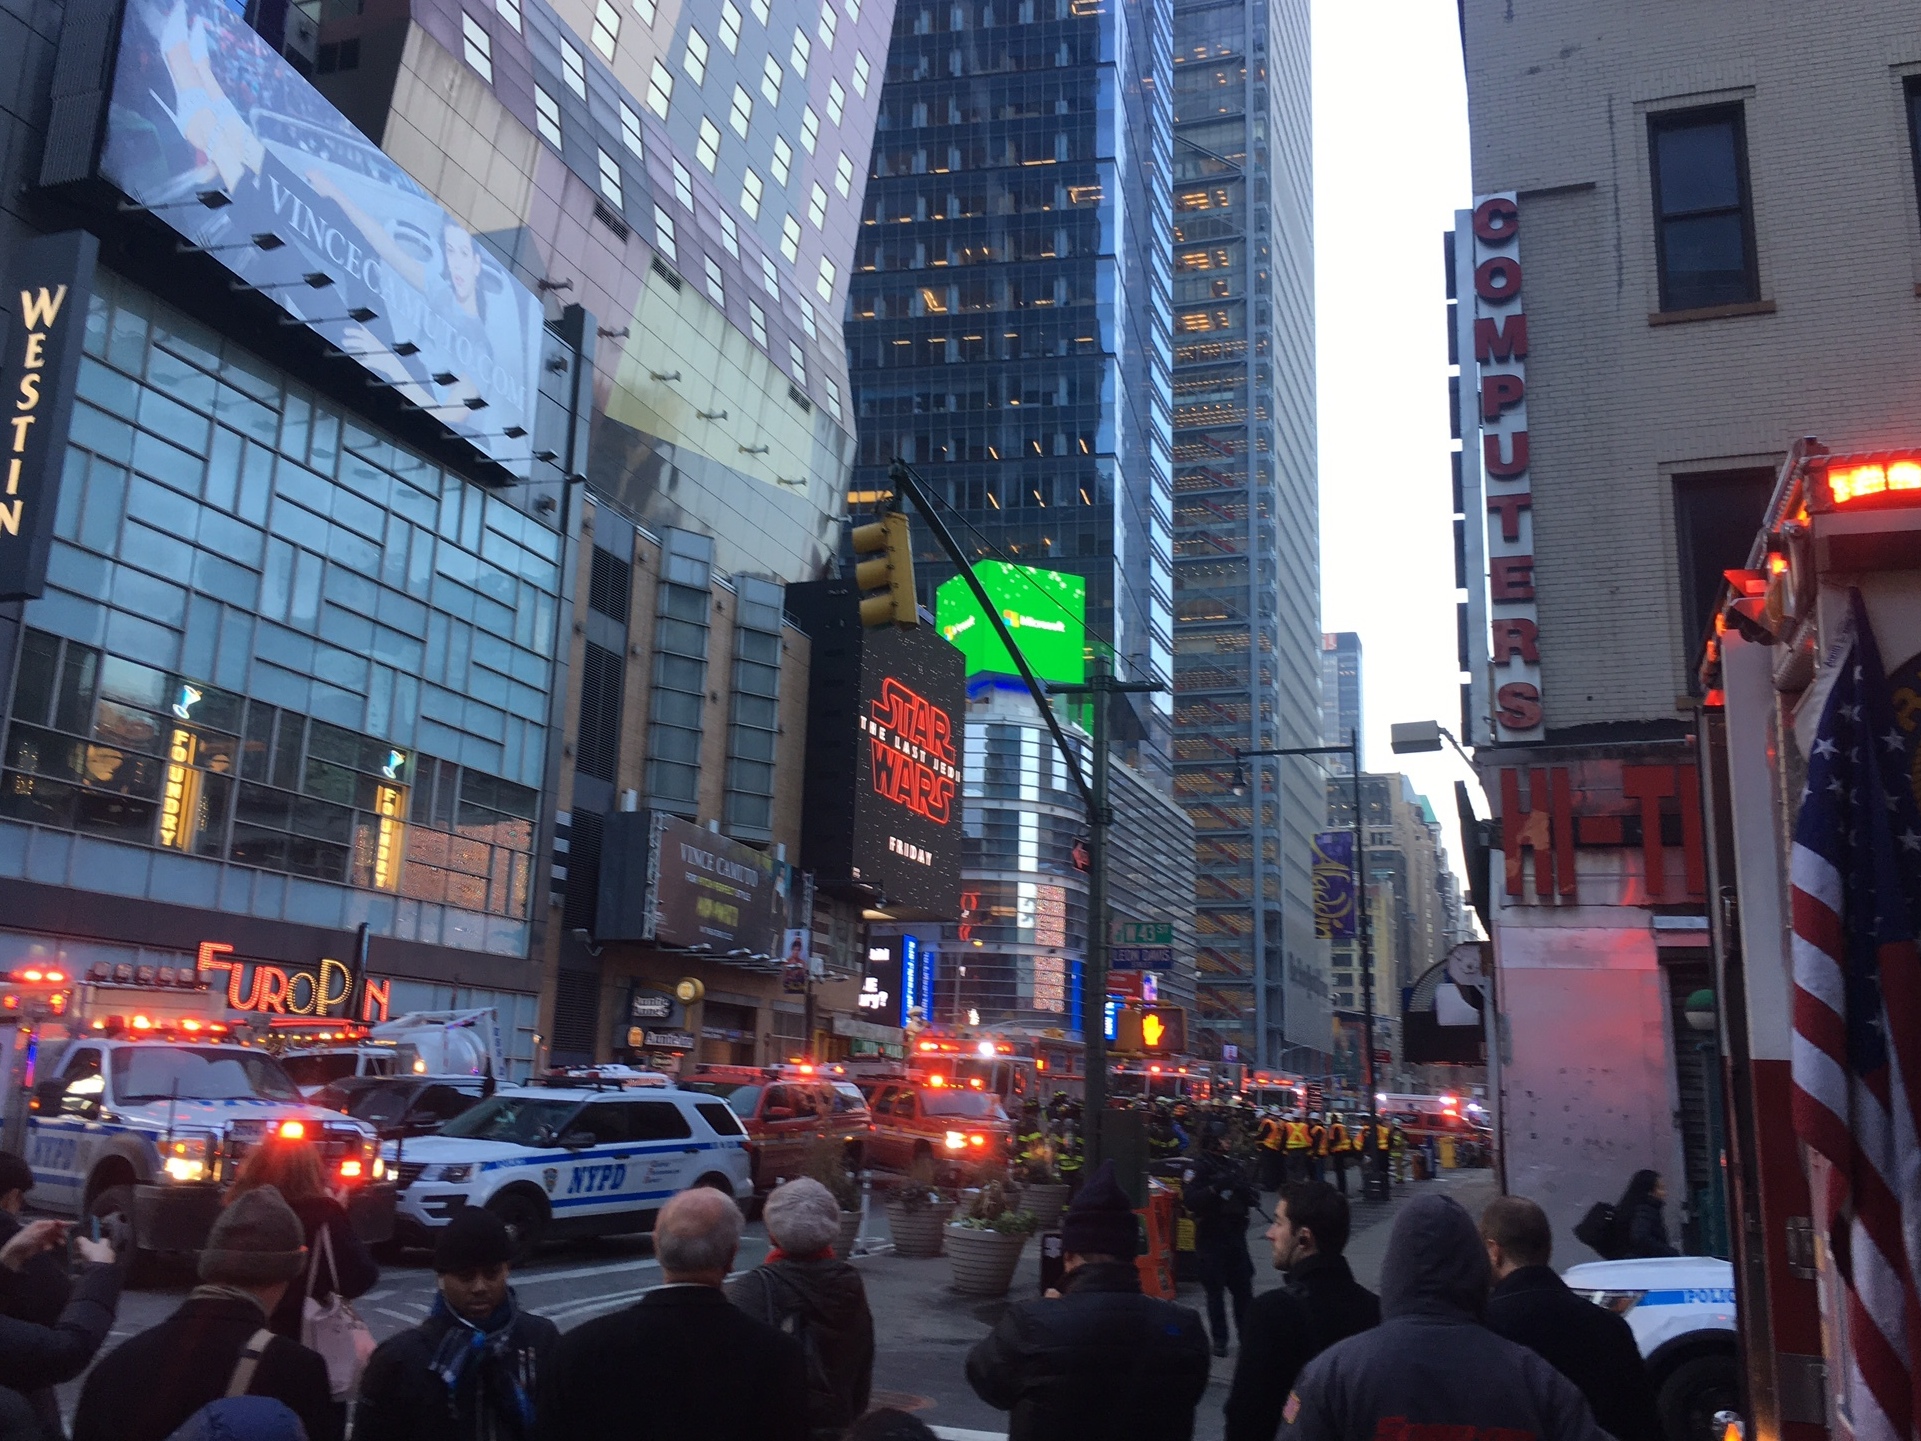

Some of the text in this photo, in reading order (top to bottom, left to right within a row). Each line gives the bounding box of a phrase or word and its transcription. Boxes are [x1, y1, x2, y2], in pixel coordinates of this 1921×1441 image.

[0, 284, 69, 537] WESTIN
[1472, 197, 1543, 732] COMPUTERS
[859, 715, 962, 783] THE LAST JEDI
[870, 676, 957, 767] STAR
[160, 728, 190, 847] FOUNDRY
[869, 736, 956, 825] WARS
[375, 787, 397, 888] FOUNDRY
[888, 835, 933, 867] FRIDAY
[1138, 924, 1157, 942] 43
[567, 1163, 628, 1195] NYPD
